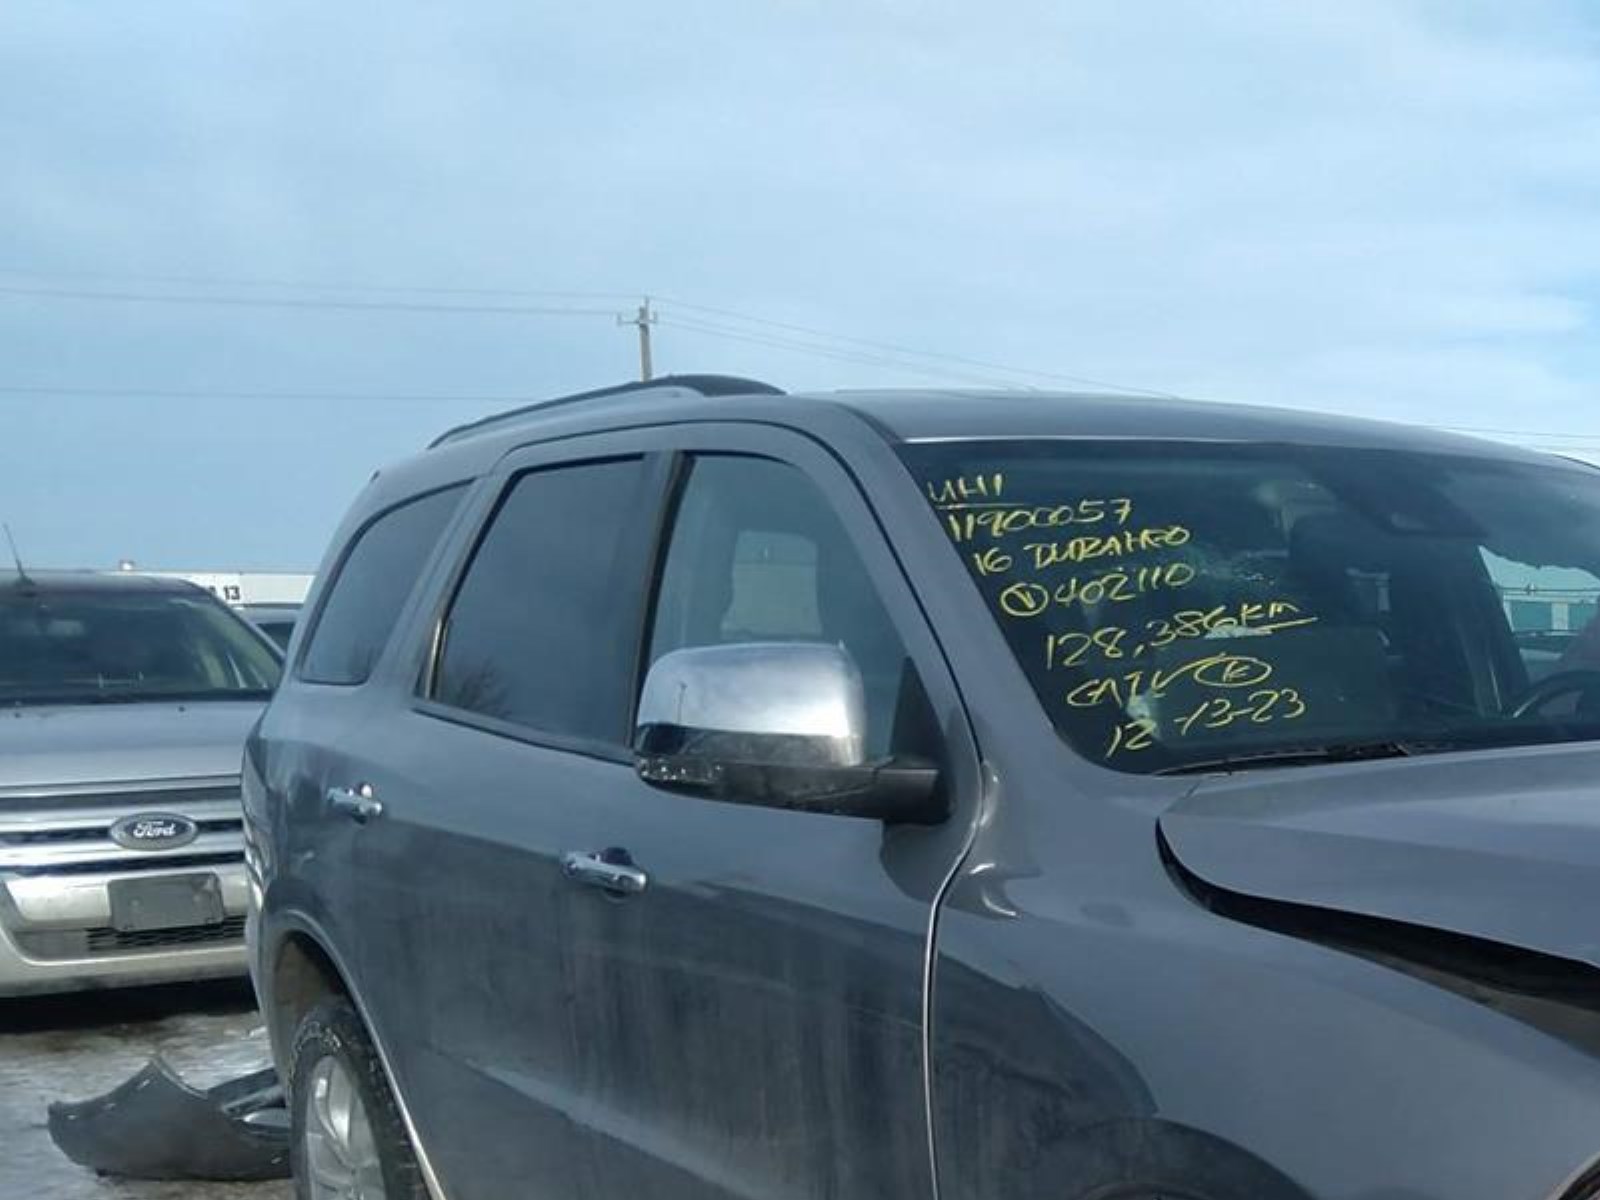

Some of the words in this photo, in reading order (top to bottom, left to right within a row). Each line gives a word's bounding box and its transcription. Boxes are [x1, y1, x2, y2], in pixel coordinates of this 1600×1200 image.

[948, 499, 1132, 543] 11900057
[973, 546, 1012, 576] 16
[1055, 562, 1195, 607] 402110
[132, 820, 177, 839] Ford
